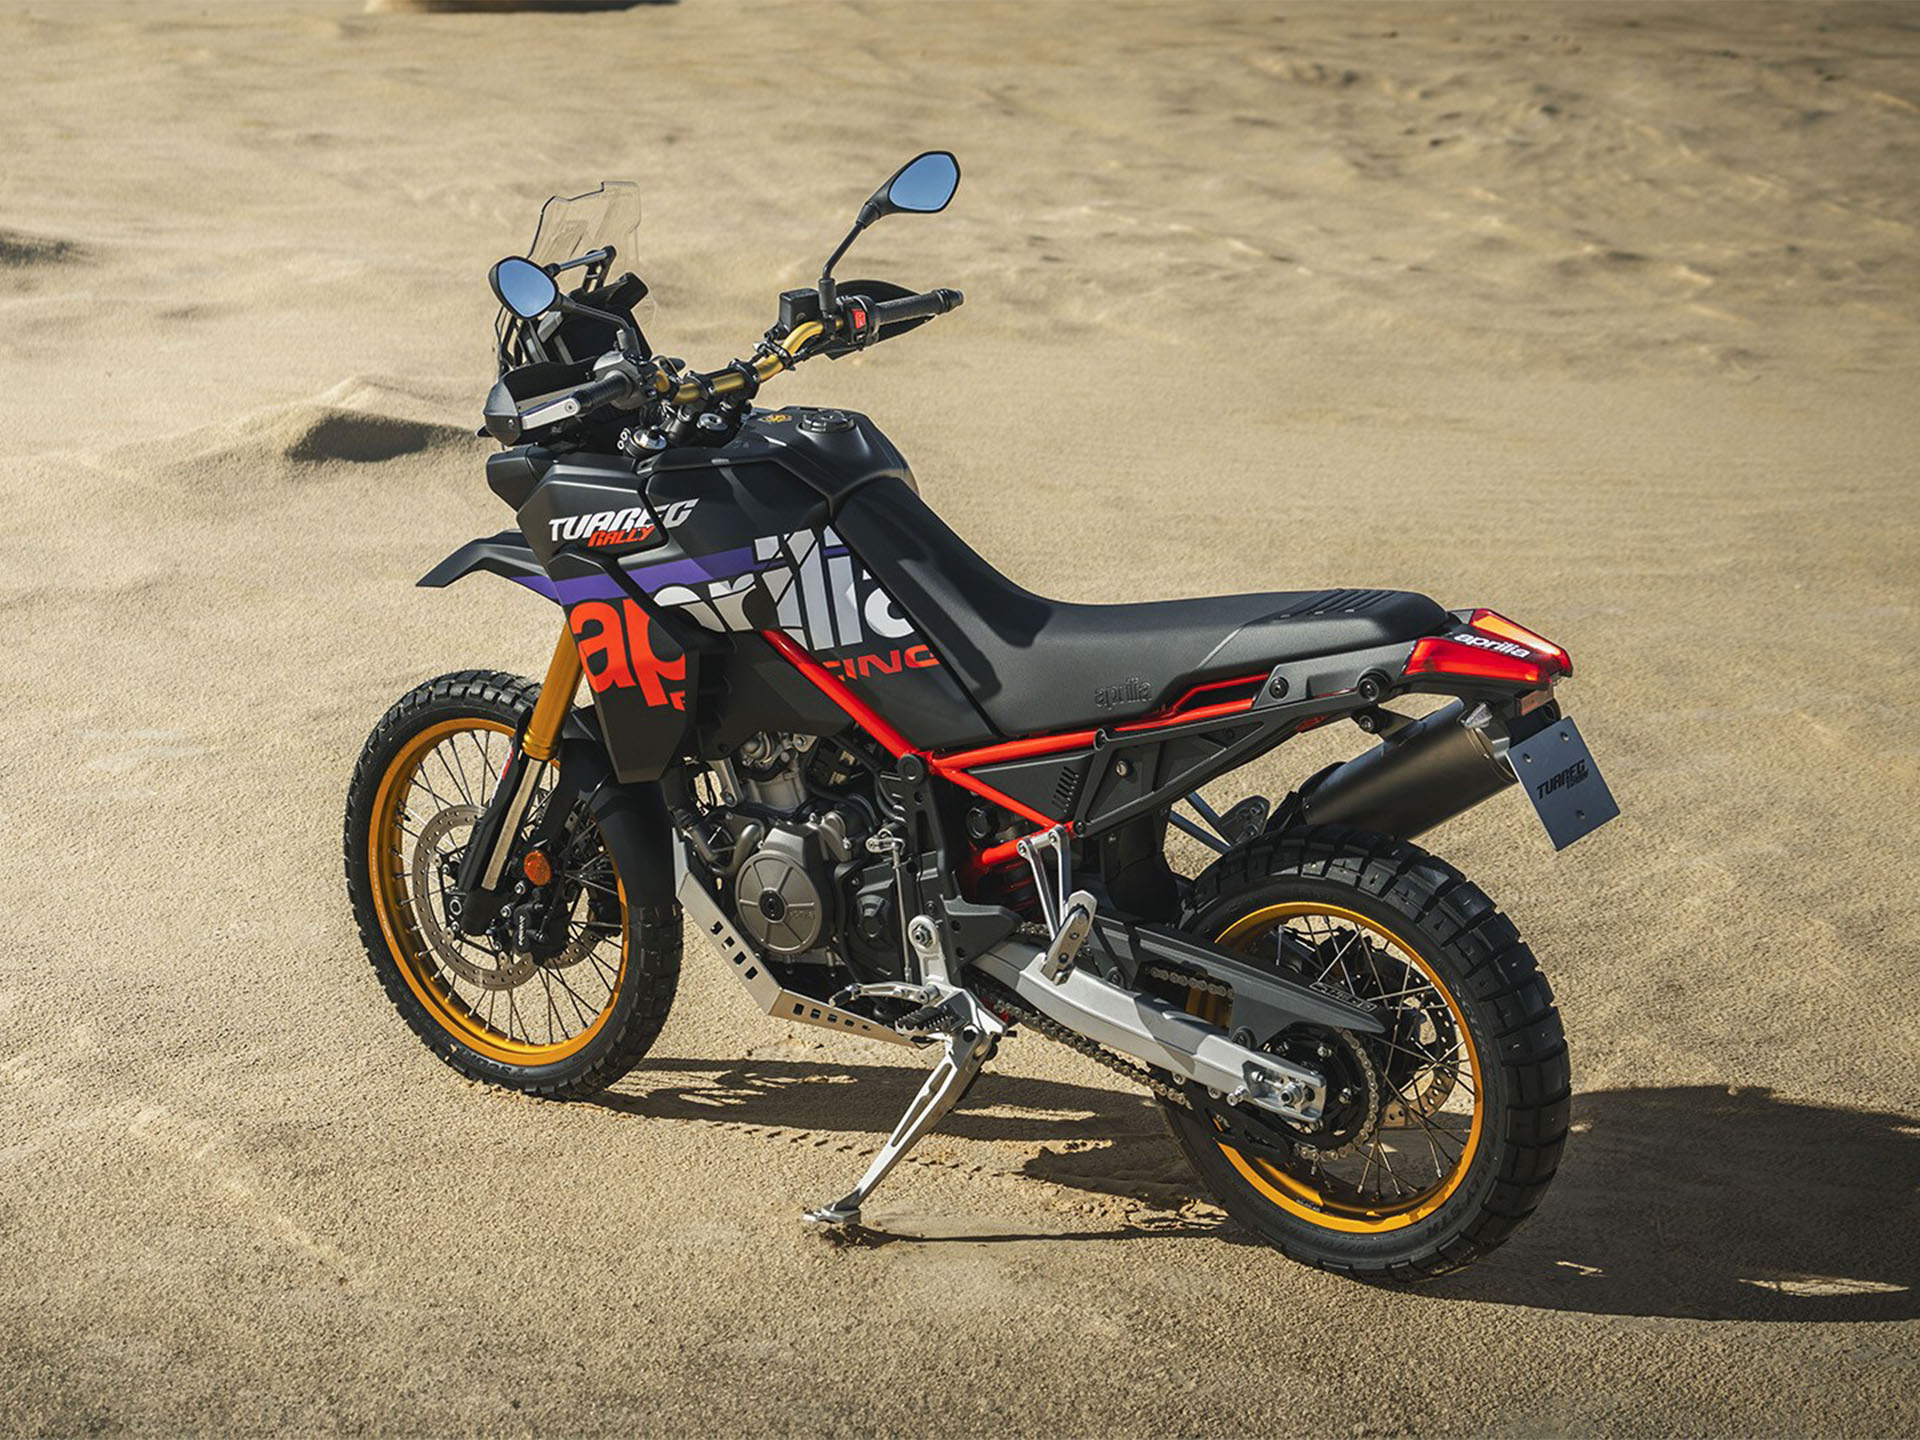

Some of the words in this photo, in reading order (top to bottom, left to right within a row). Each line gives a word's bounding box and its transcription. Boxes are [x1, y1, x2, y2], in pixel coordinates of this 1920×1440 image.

[548, 498, 700, 542] TUAREG
[587, 525, 656, 548] RALLY
[1454, 633, 1531, 658] aprilia
[1095, 677, 1153, 711] aprilia
[1536, 758, 1585, 800] TUAREG
